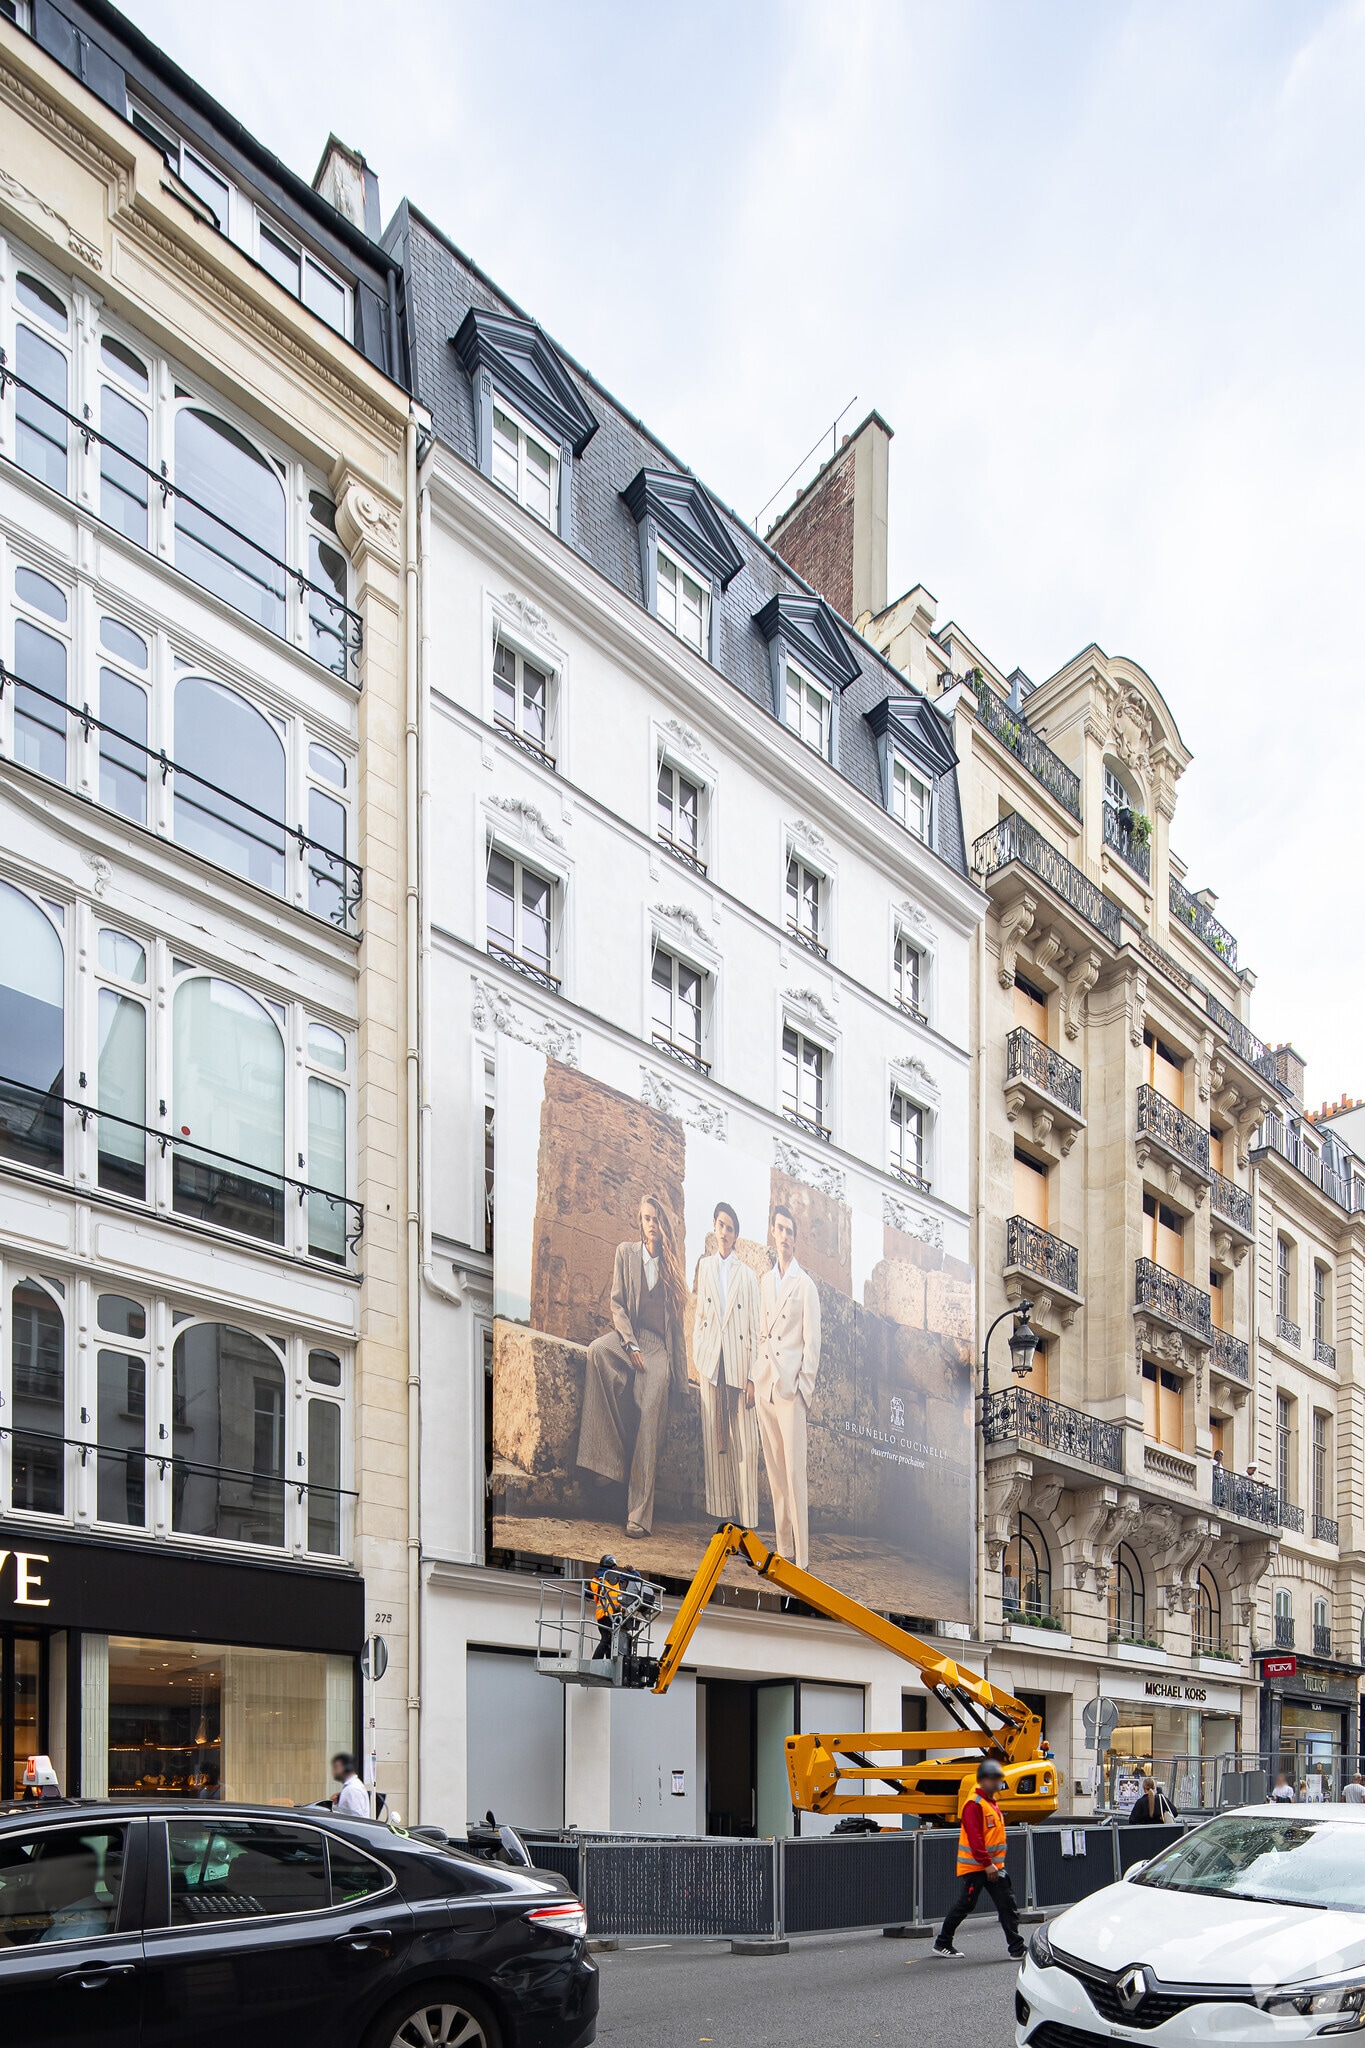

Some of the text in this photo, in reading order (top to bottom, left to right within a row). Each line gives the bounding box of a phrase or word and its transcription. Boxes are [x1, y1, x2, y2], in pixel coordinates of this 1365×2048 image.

[845, 1421, 947, 1460] BRUNELLO CUCINELLI
[870, 1447, 925, 1469] ouverture prochaine
[375, 1612, 392, 1623] 275
[1268, 1663, 1292, 1671] TUMI
[1144, 1682, 1207, 1702] MICHAEL KORS
